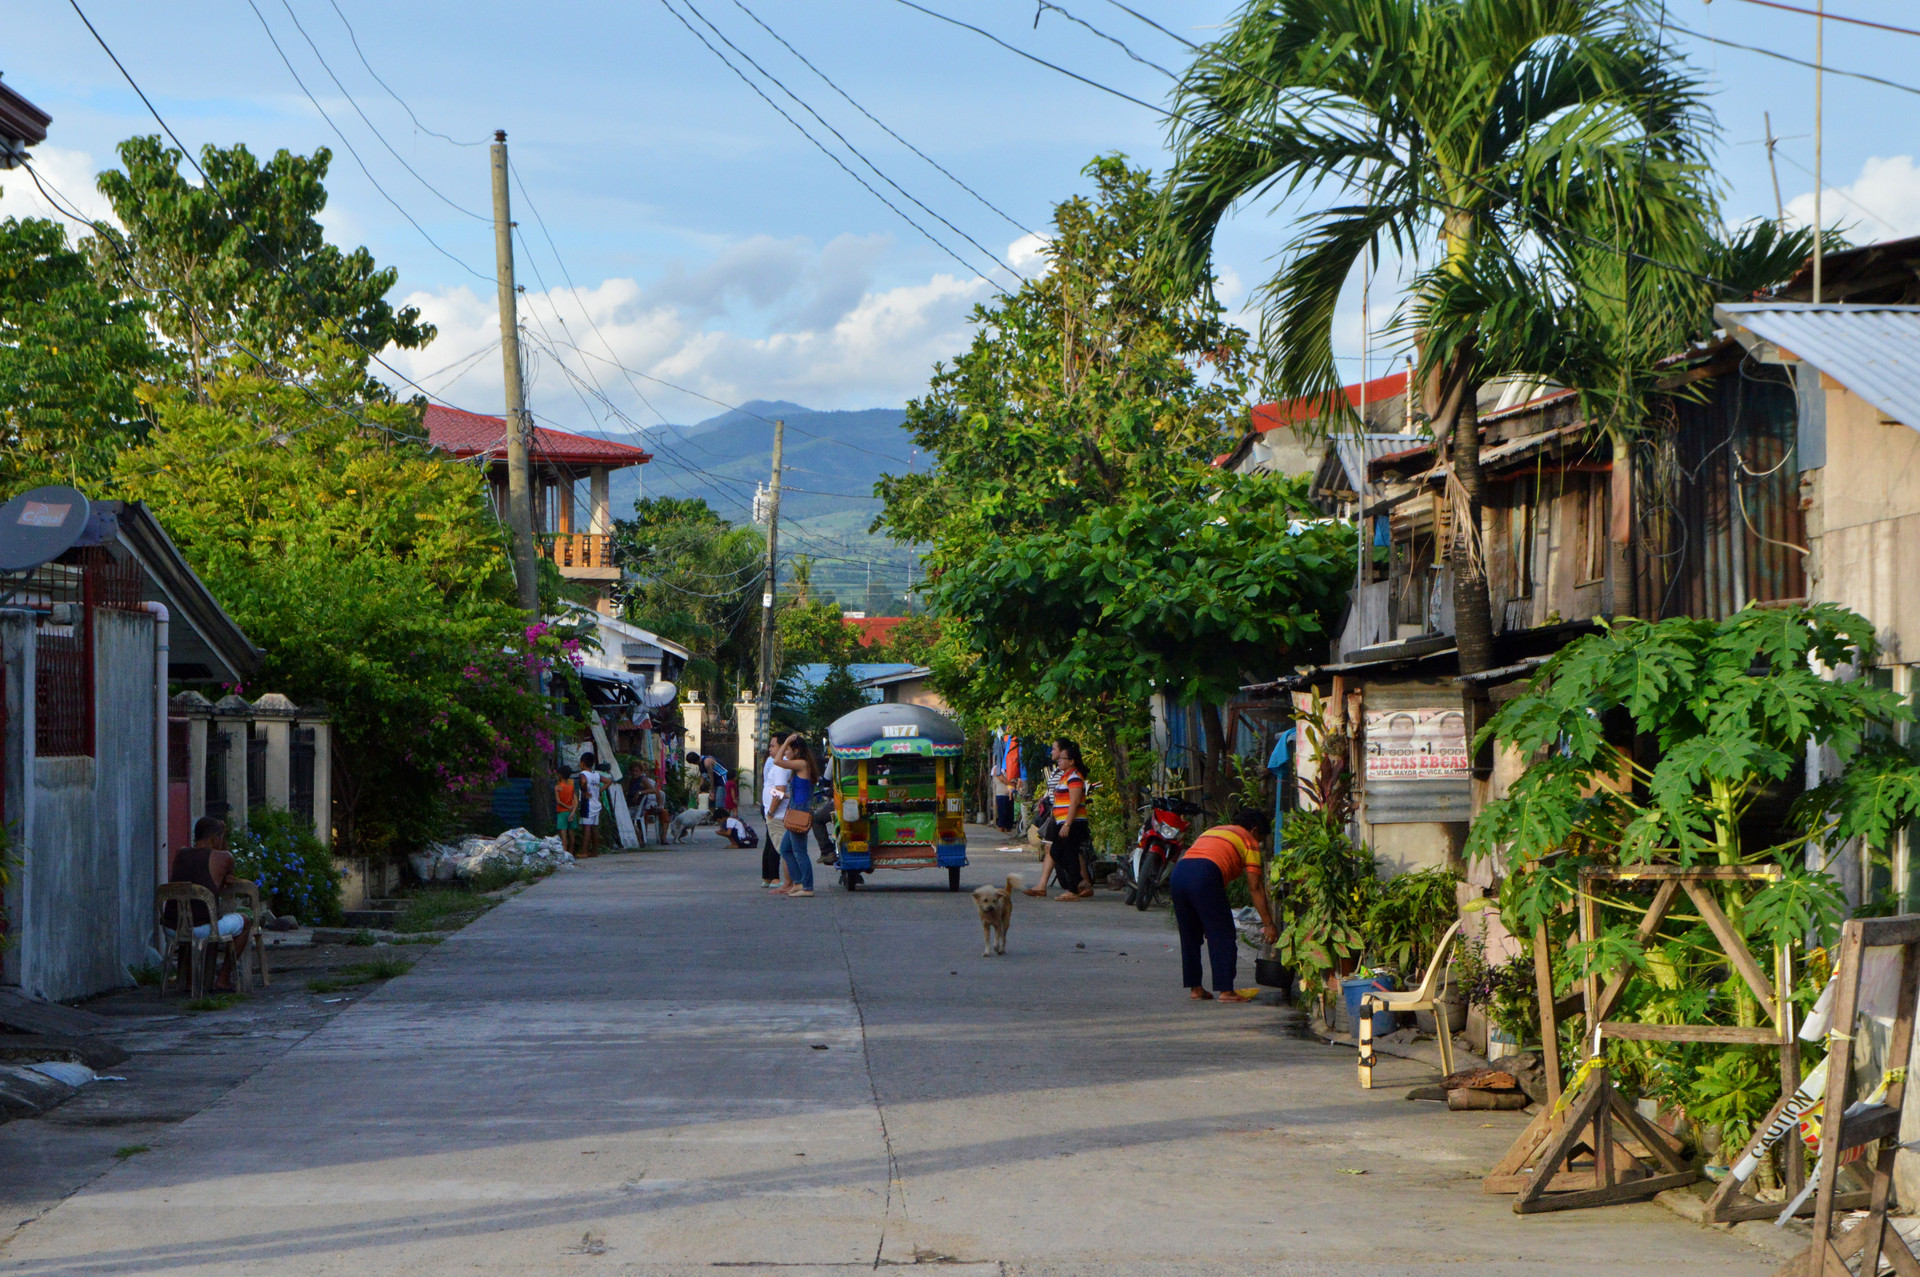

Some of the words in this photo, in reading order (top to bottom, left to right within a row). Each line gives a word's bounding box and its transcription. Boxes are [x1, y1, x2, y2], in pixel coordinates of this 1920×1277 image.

[23, 511, 64, 526] Cignal
[882, 725, 918, 737] 1677
[1439, 748, 1465, 756] GODI
[1369, 756, 1417, 770] EBCAS
[1419, 755, 1467, 769] EBCAS
[888, 789, 907, 798] 1677
[1751, 1089, 1814, 1158] CAUTION
